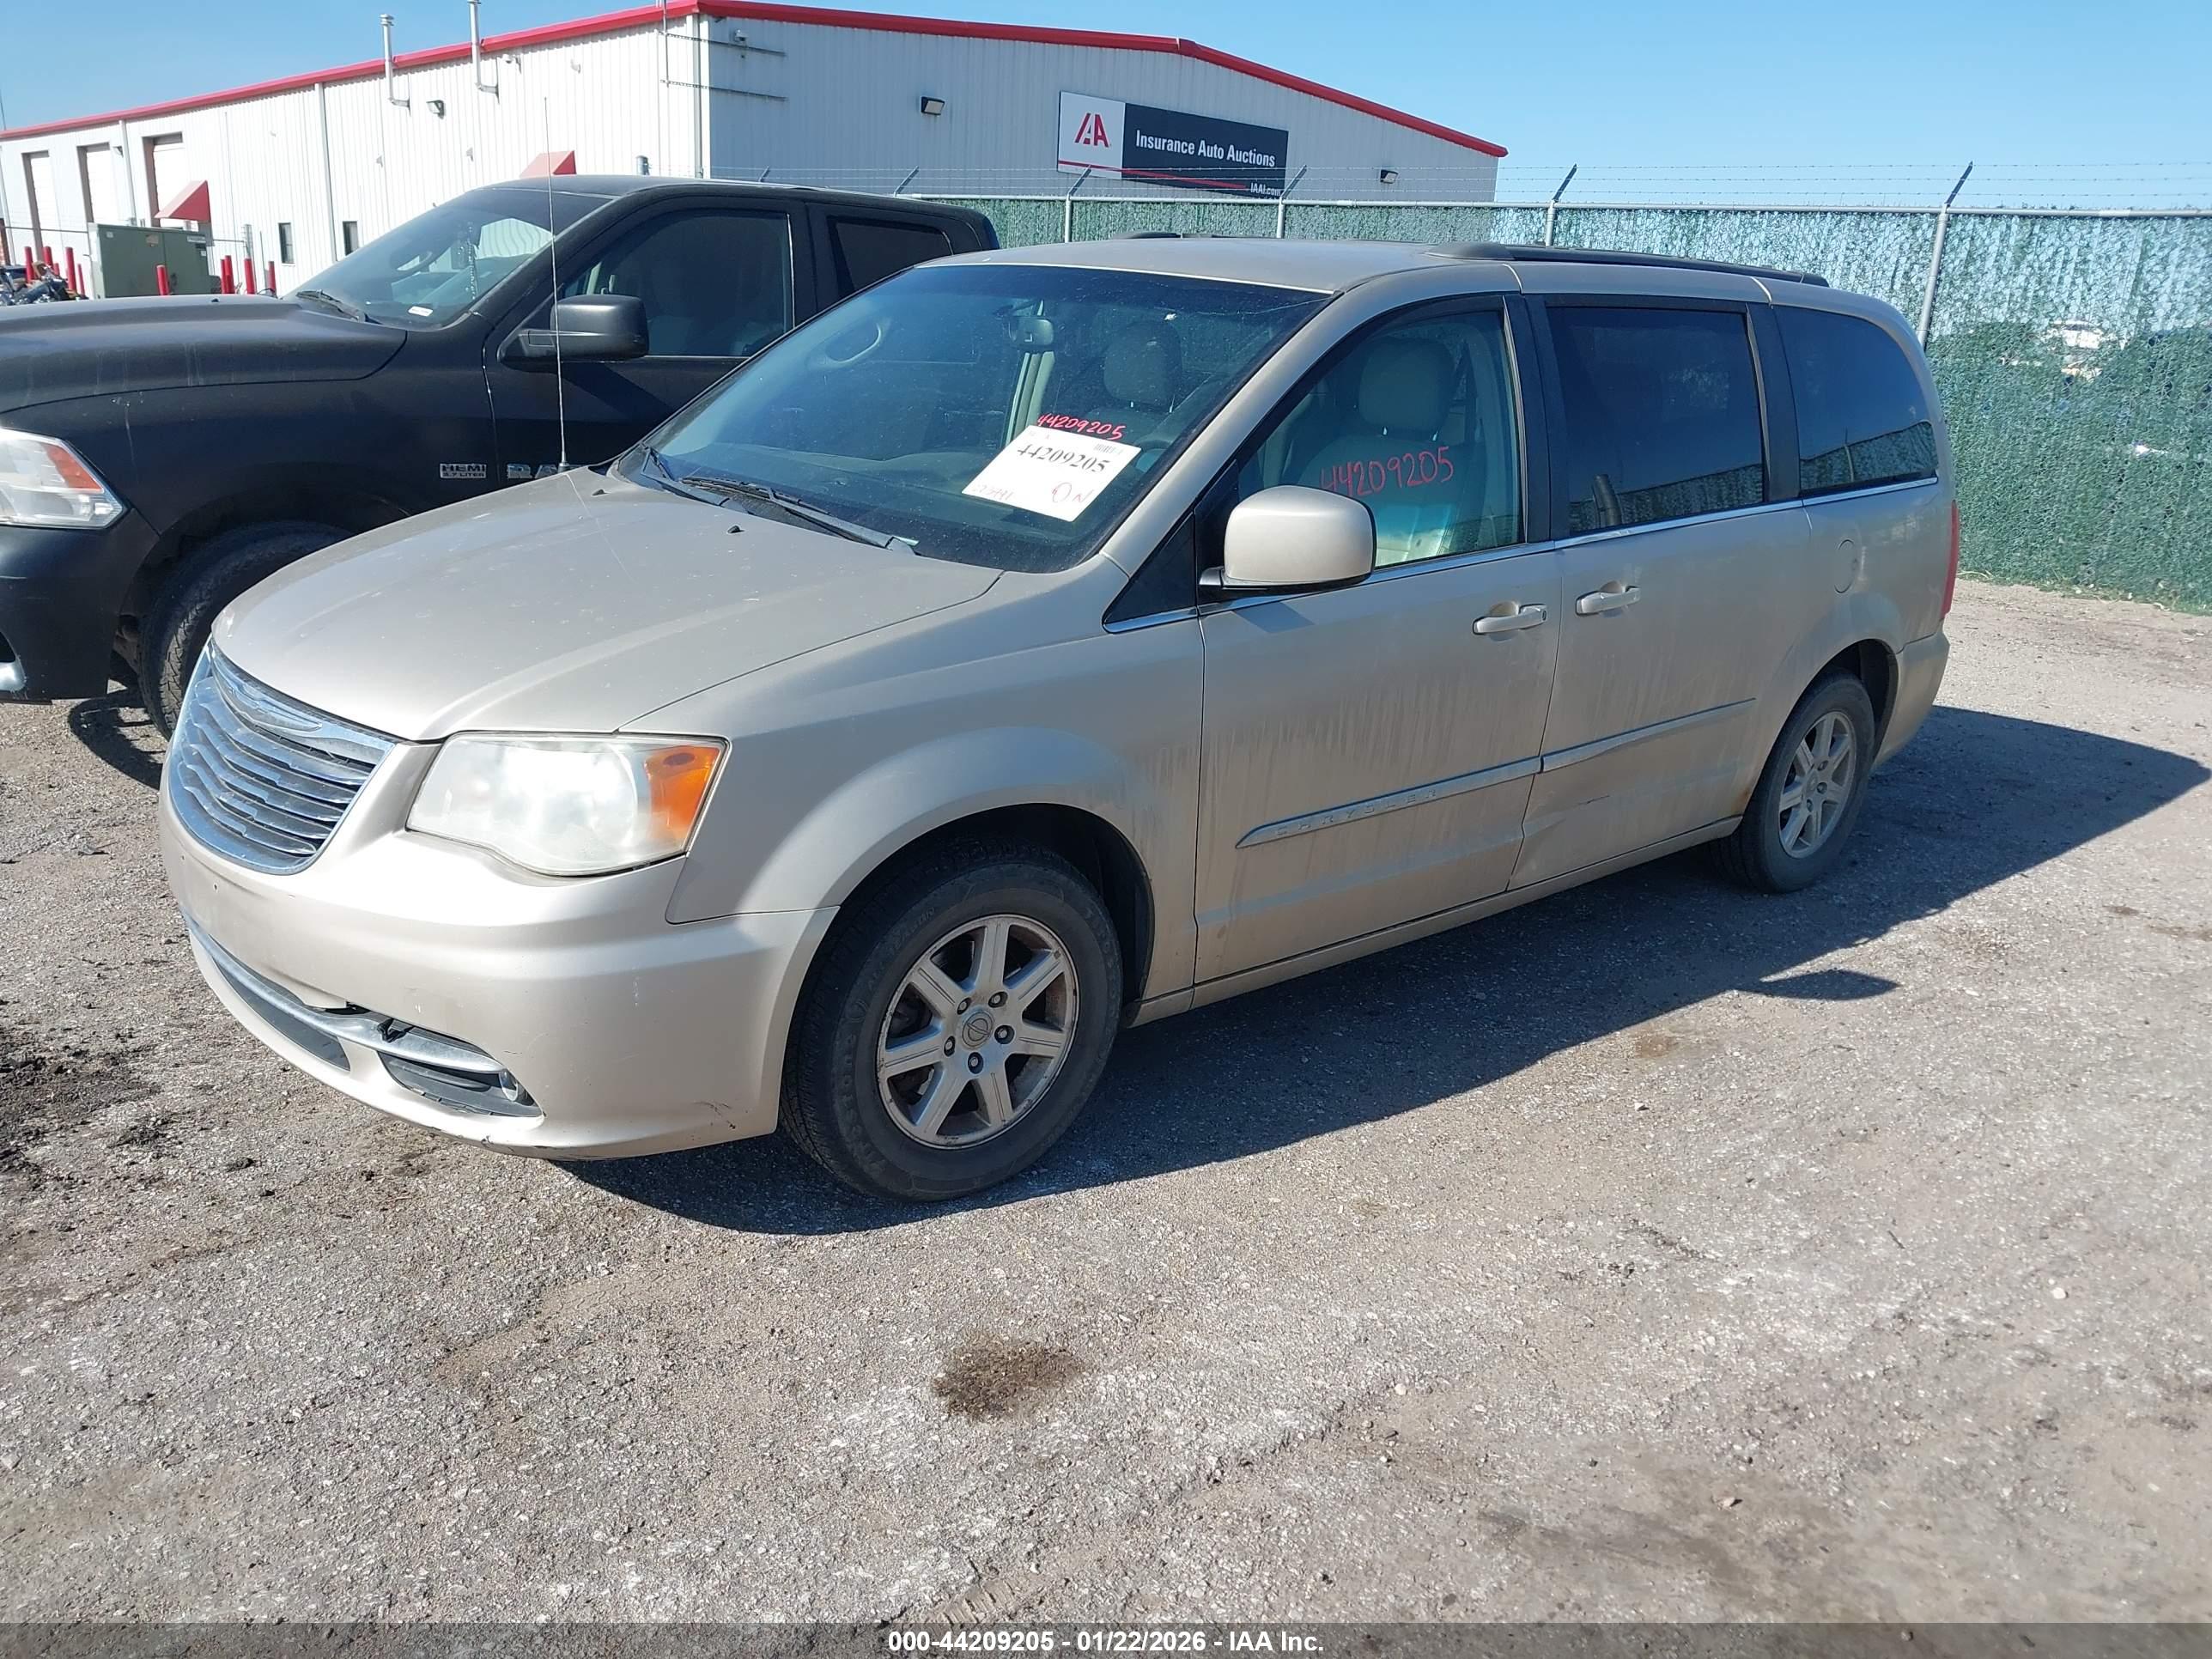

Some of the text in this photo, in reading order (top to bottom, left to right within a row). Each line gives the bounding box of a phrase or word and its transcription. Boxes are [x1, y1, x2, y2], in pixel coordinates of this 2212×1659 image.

[1135, 130, 1276, 168] Insurance Auto Auctions
[1250, 182, 1281, 197] IAAI.com
[1037, 413, 1127, 441] 44209205
[1017, 444, 1110, 472] 44209205
[1320, 446, 1454, 496] 44209205
